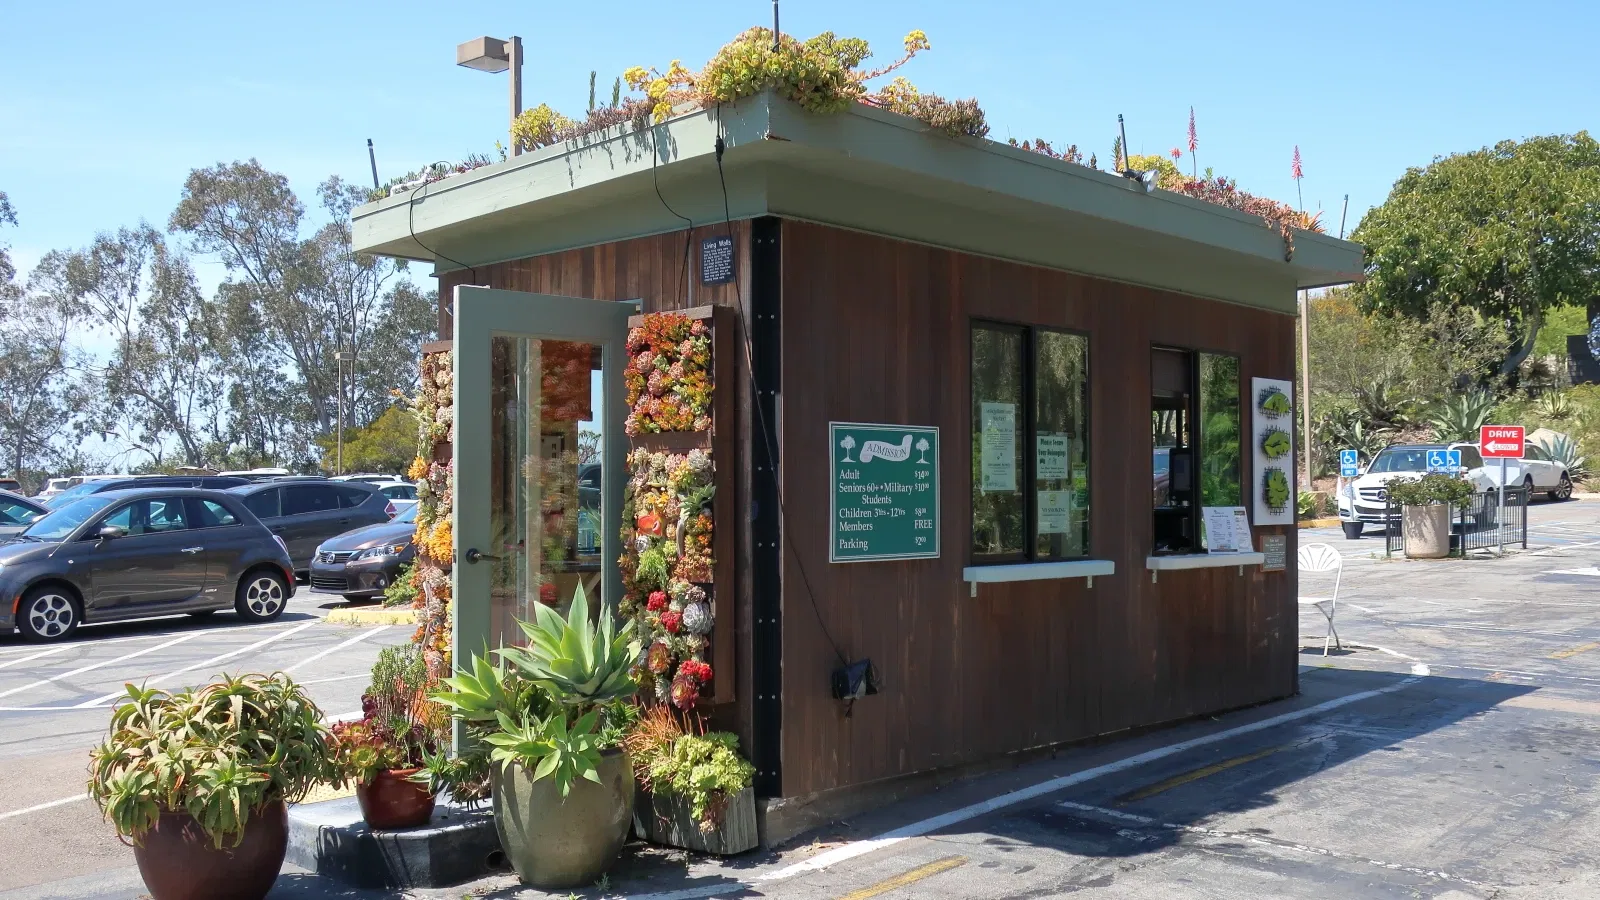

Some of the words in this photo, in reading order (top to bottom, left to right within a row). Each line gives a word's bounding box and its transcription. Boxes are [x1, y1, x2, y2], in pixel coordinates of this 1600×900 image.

[1488, 430, 1519, 438] DRIVE
[866, 443, 907, 459] ADMISSION
[839, 469, 860, 480] Adult
[839, 482, 866, 493] Seniors
[866, 482, 879, 493] 60+
[884, 482, 913, 495] Military
[861, 494, 892, 505] Students
[839, 508, 872, 518] Children
[839, 521, 873, 532] Members
[914, 519, 933, 529] FREE
[839, 538, 869, 551] Parking
